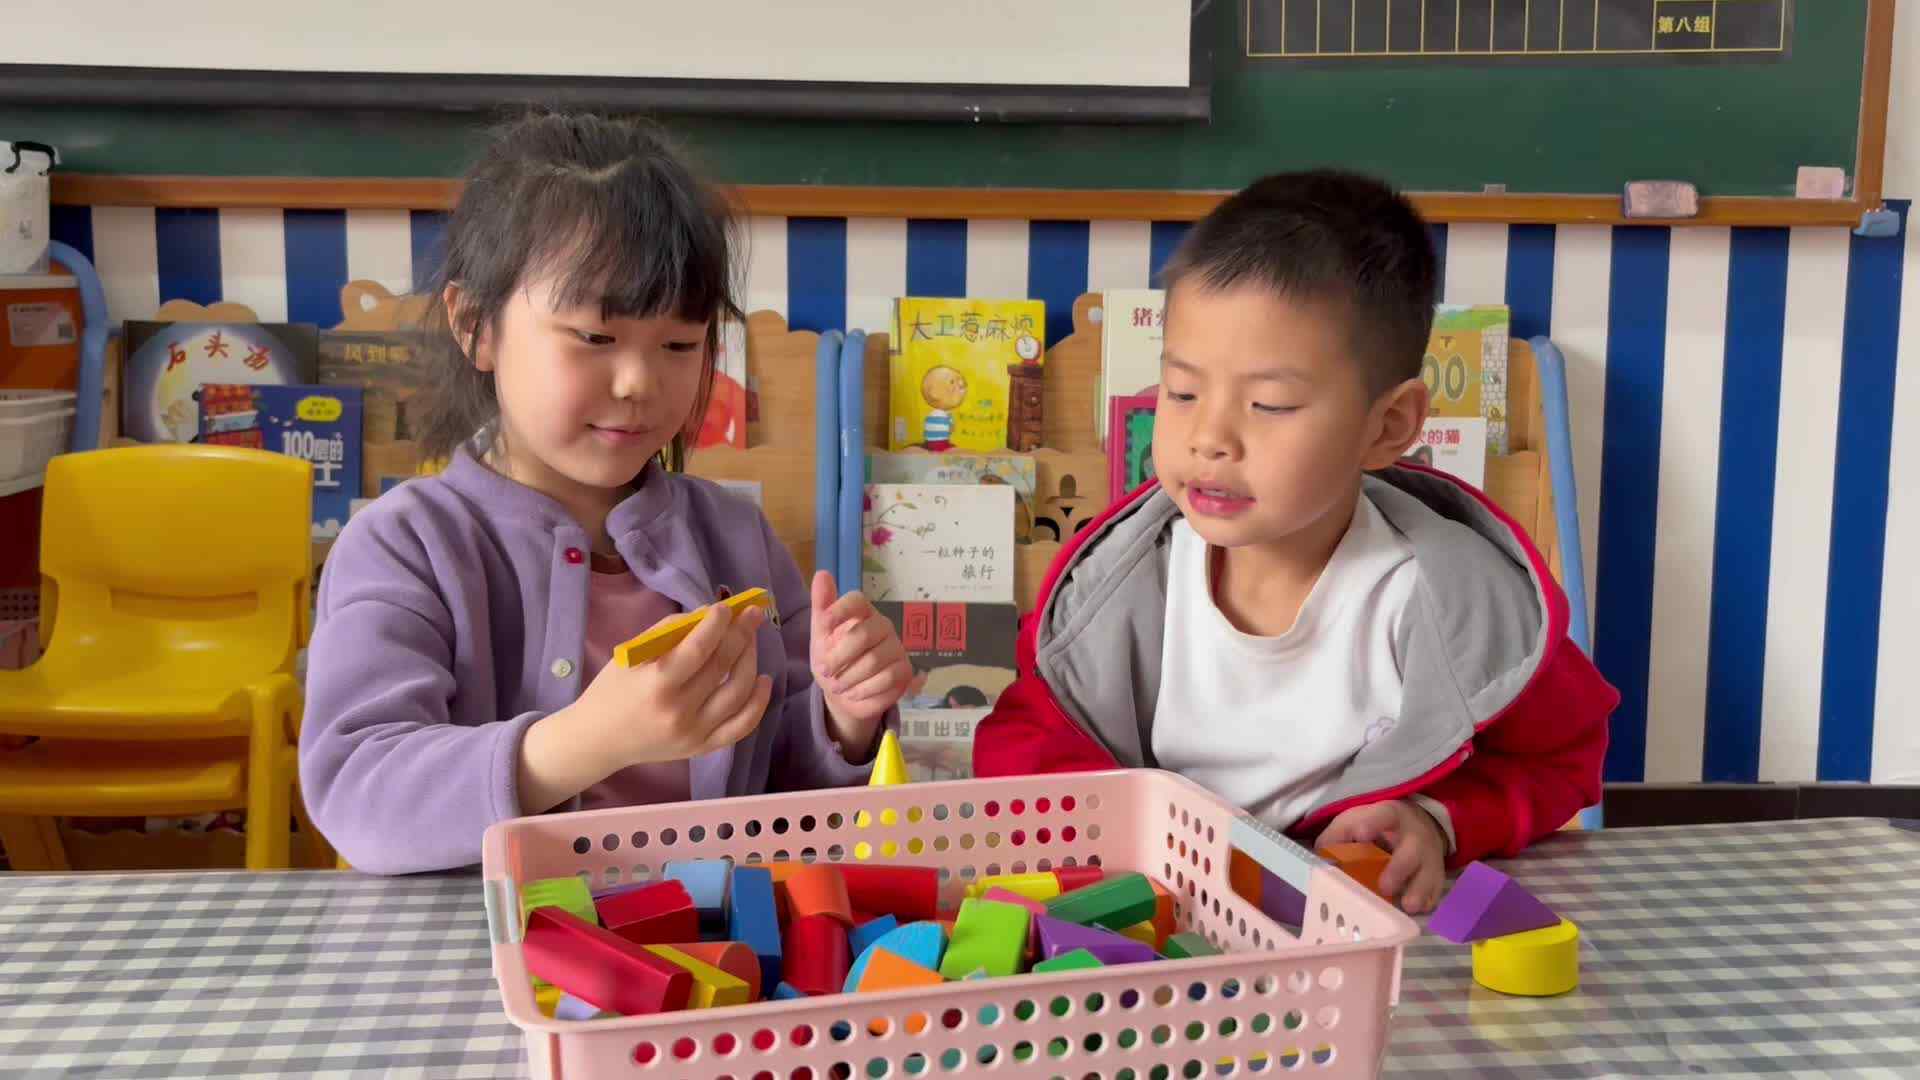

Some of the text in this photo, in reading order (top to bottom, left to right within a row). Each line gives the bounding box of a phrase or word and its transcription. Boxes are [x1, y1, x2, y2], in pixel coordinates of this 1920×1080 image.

[1657, 16, 1711, 33] 第八组
[909, 311, 1033, 343] 大卫惹麻烦
[167, 330, 270, 371] 石头汤
[920, 546, 995, 560] 一粒种子的
[961, 564, 995, 581] 旅行
